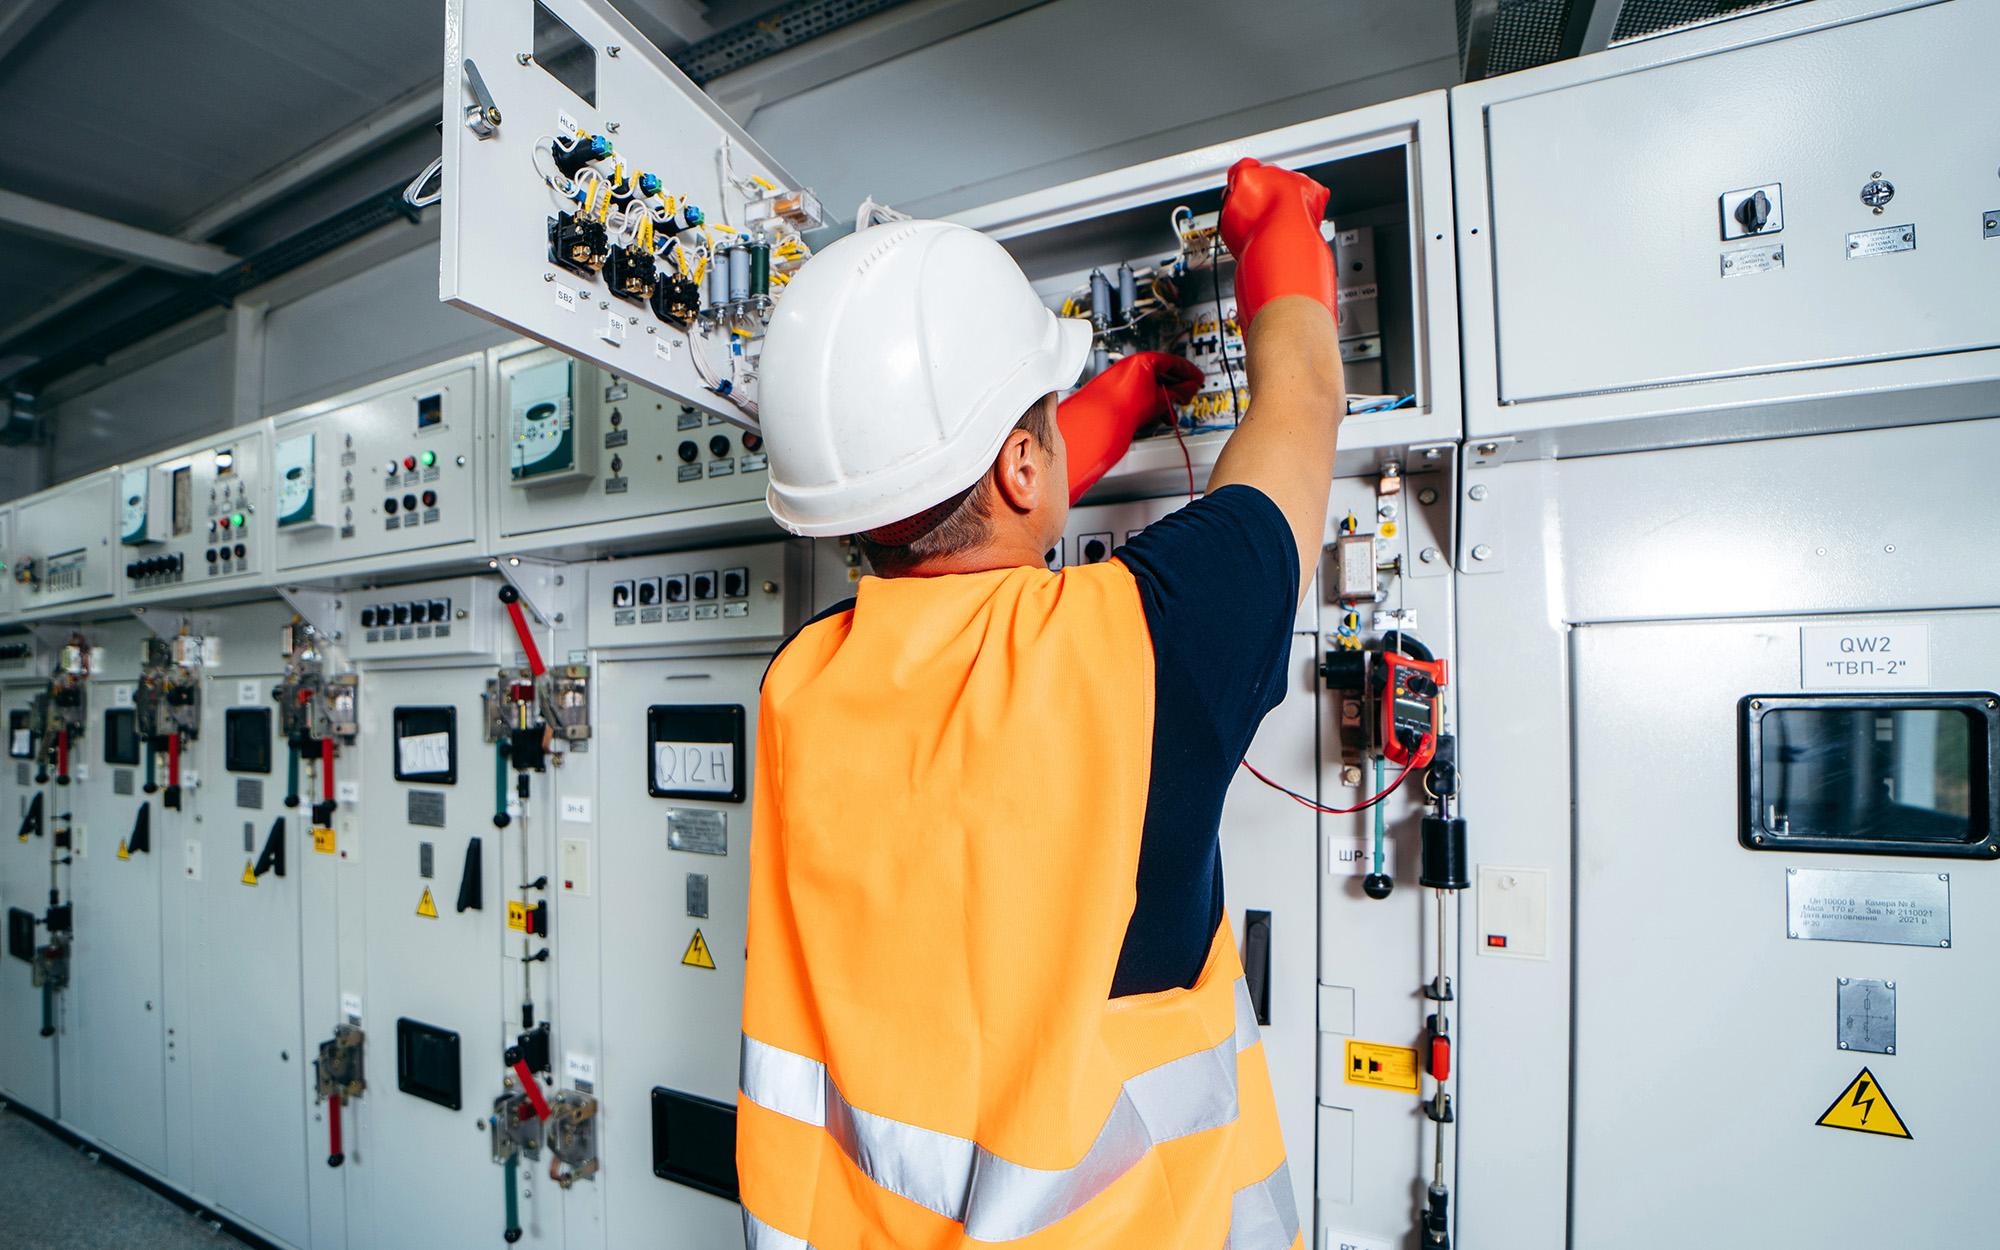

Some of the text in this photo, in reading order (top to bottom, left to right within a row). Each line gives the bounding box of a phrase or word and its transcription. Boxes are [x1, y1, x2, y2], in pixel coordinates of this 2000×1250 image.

[560, 115, 576, 132] HLG
[557, 290, 573, 305] SB2
[610, 319, 624, 331] SB1
[1840, 636, 1892, 653] QW2
[1826, 659, 1906, 675] "ТВП-2"
[1824, 898, 1848, 906] 10000
[1865, 899, 1897, 908] Камера
[1910, 900, 1916, 908] 8
[1803, 904, 1824, 912] Маса
[1832, 905, 1846, 913] 170
[1898, 908, 1933, 917] 2110021
[1811, 919, 1820, 927] 20
[1899, 915, 1919, 924] 2021
